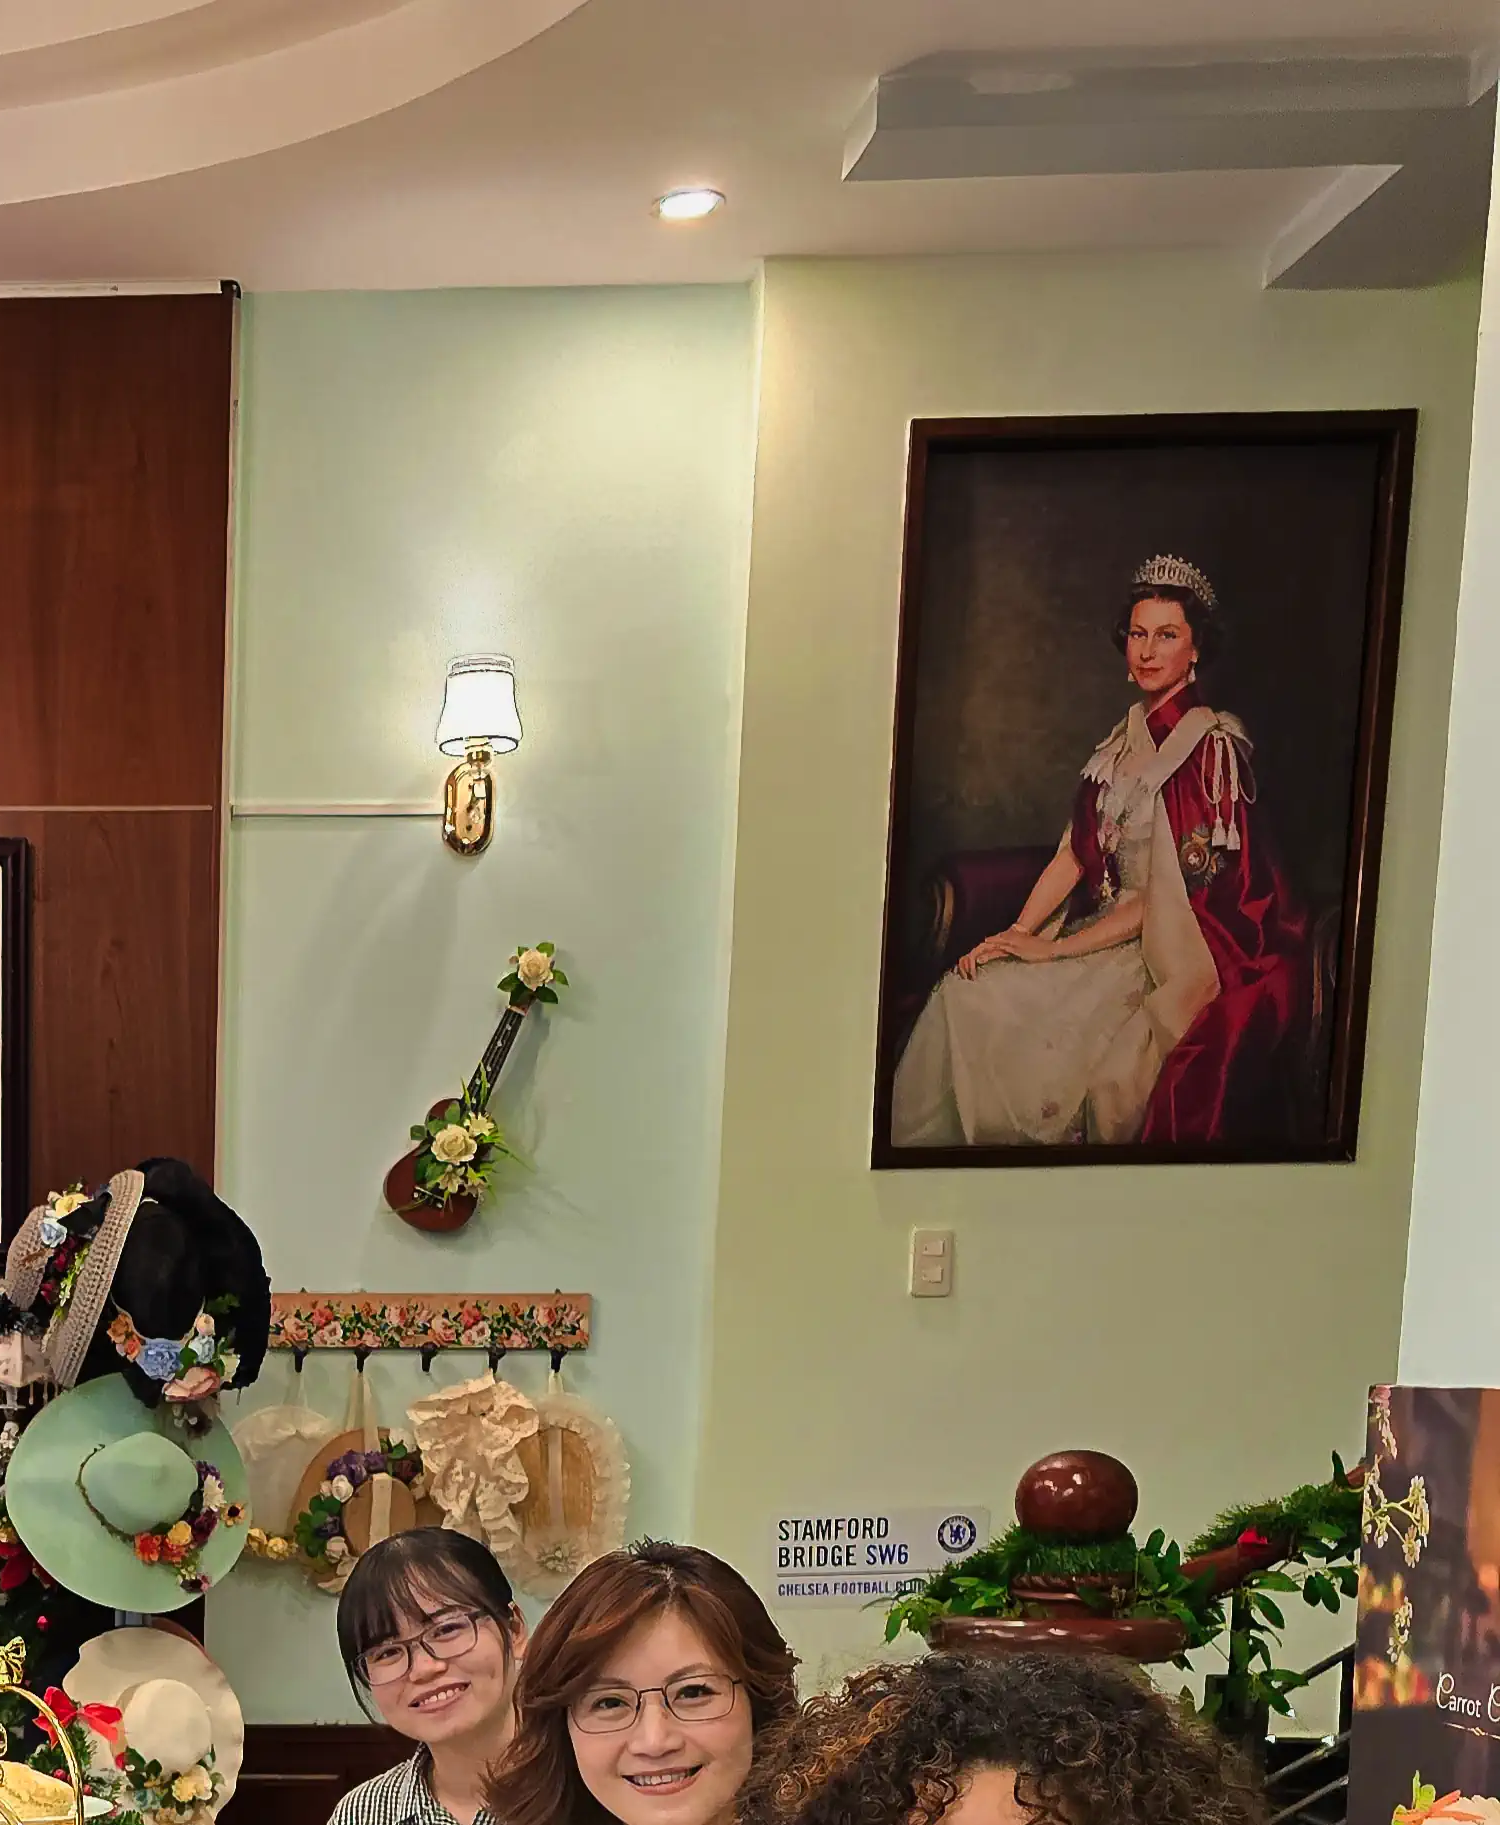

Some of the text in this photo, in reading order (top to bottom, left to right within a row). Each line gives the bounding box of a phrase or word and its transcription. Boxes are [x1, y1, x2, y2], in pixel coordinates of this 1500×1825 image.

[778, 1517, 889, 1541] STAMFORD
[778, 1544, 909, 1568] BRIDGE SW6
[778, 1582, 830, 1597] CHELSEA
[833, 1580, 891, 1595] FOOTBALL
[1436, 1671, 1482, 1718] Carrot
